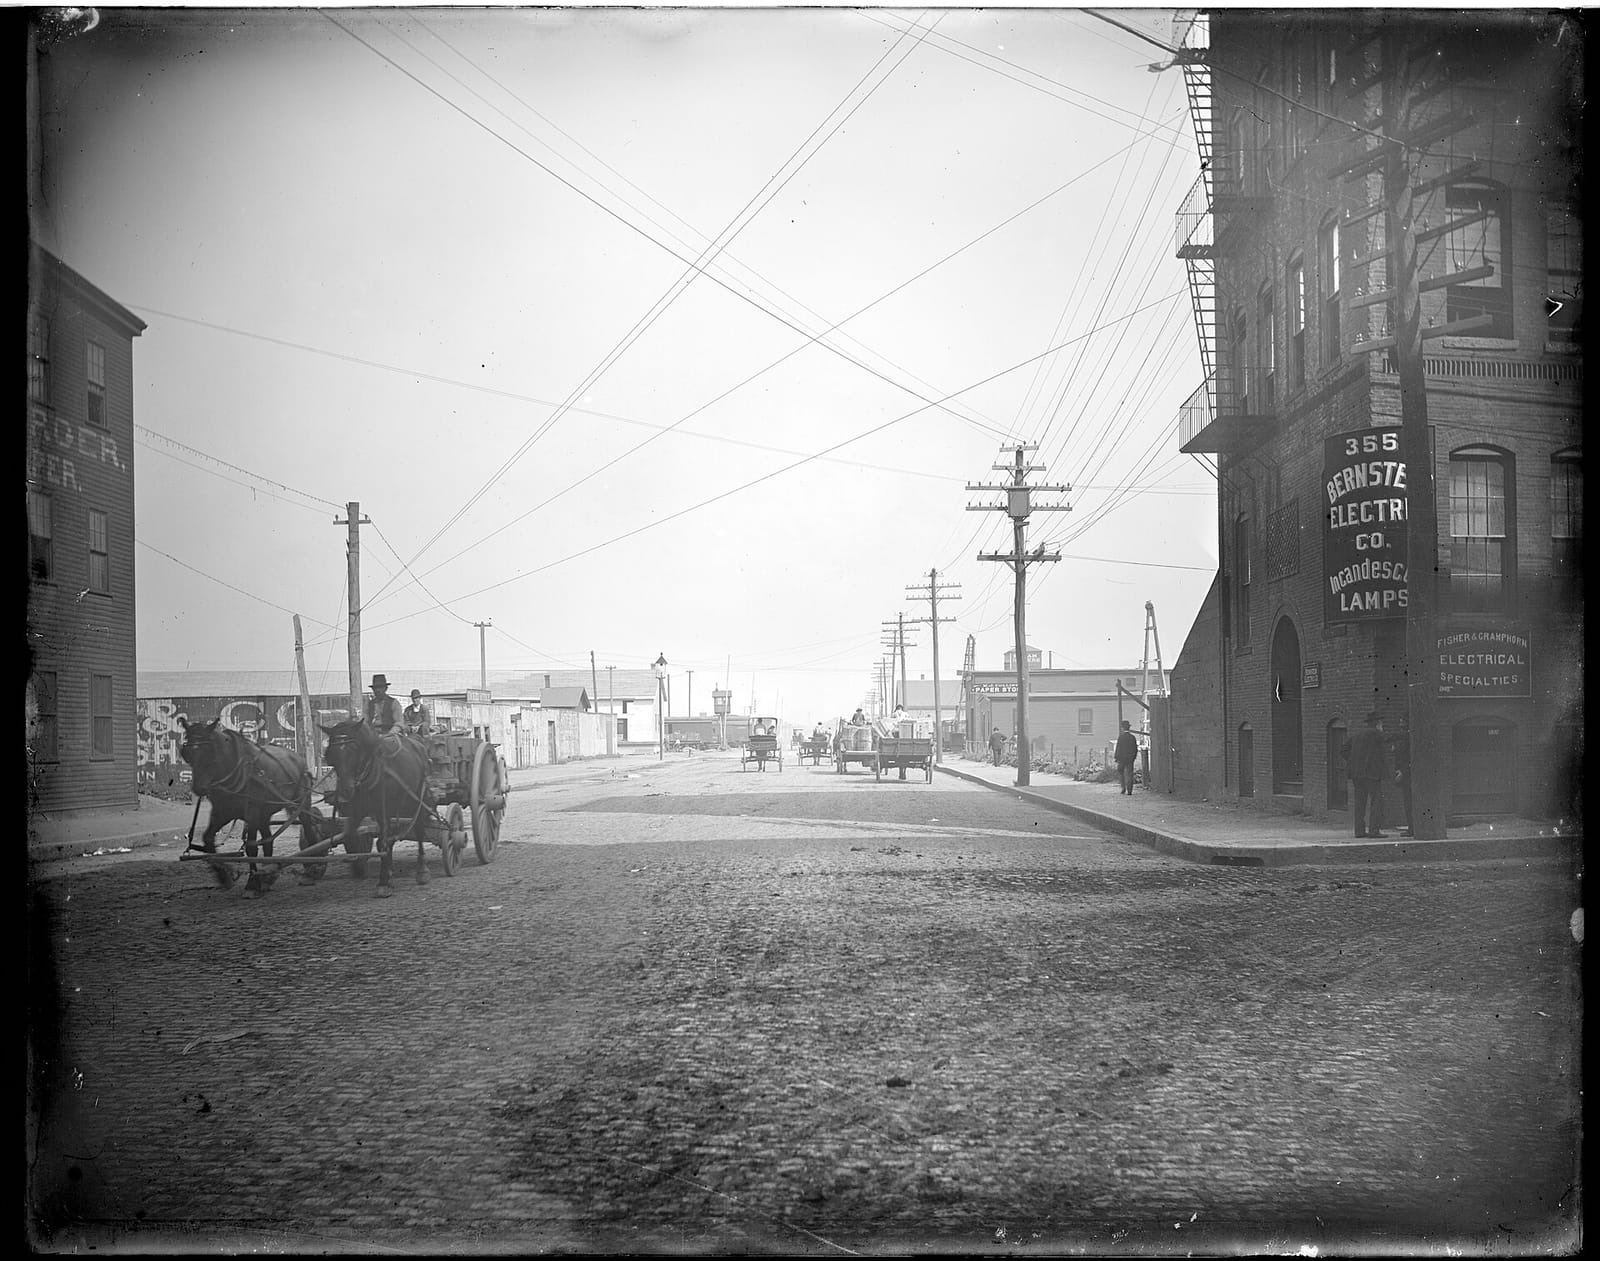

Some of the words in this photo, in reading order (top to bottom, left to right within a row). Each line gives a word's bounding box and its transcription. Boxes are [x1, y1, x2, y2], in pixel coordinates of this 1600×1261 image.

[1345, 432, 1398, 456] 355
[1355, 531, 1392, 550] CO.
[1340, 588, 1408, 612] LAMPS
[1437, 633, 1470, 649] FISHER
[1439, 653, 1525, 665] ELECTRICAL
